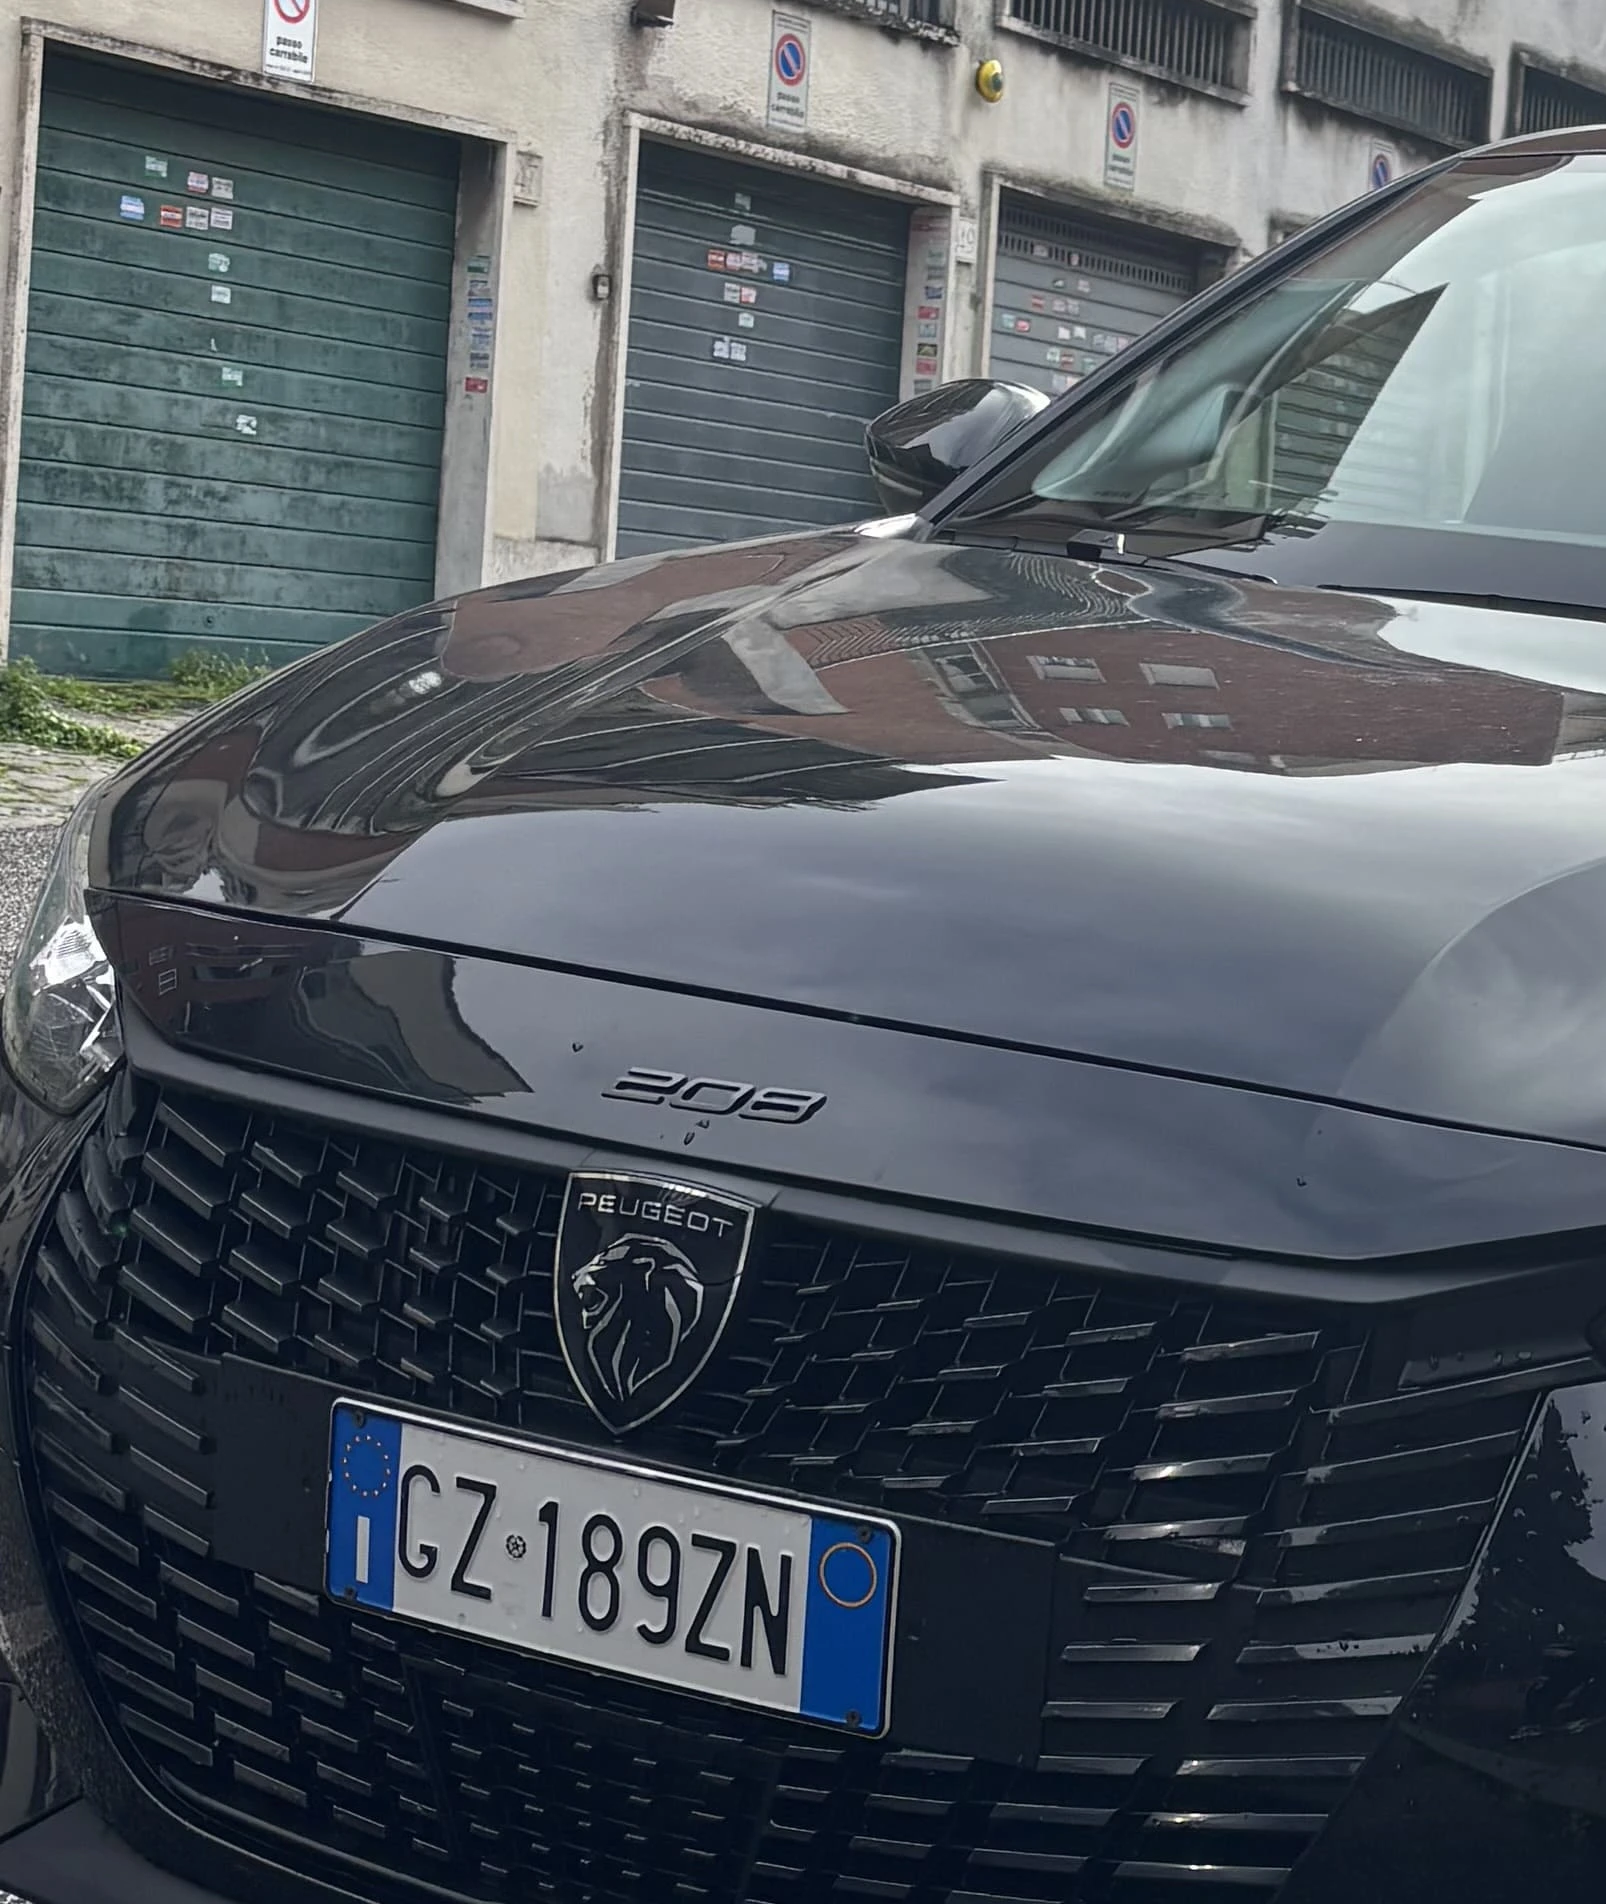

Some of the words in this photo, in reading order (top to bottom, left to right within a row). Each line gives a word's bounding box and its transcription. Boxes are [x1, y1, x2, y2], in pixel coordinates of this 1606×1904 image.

[601, 1067, 828, 1125] 208
[577, 1192, 734, 1238] PEUGEOT
[399, 1464, 498, 1601] GZ
[537, 1500, 793, 1676] 189ZN
